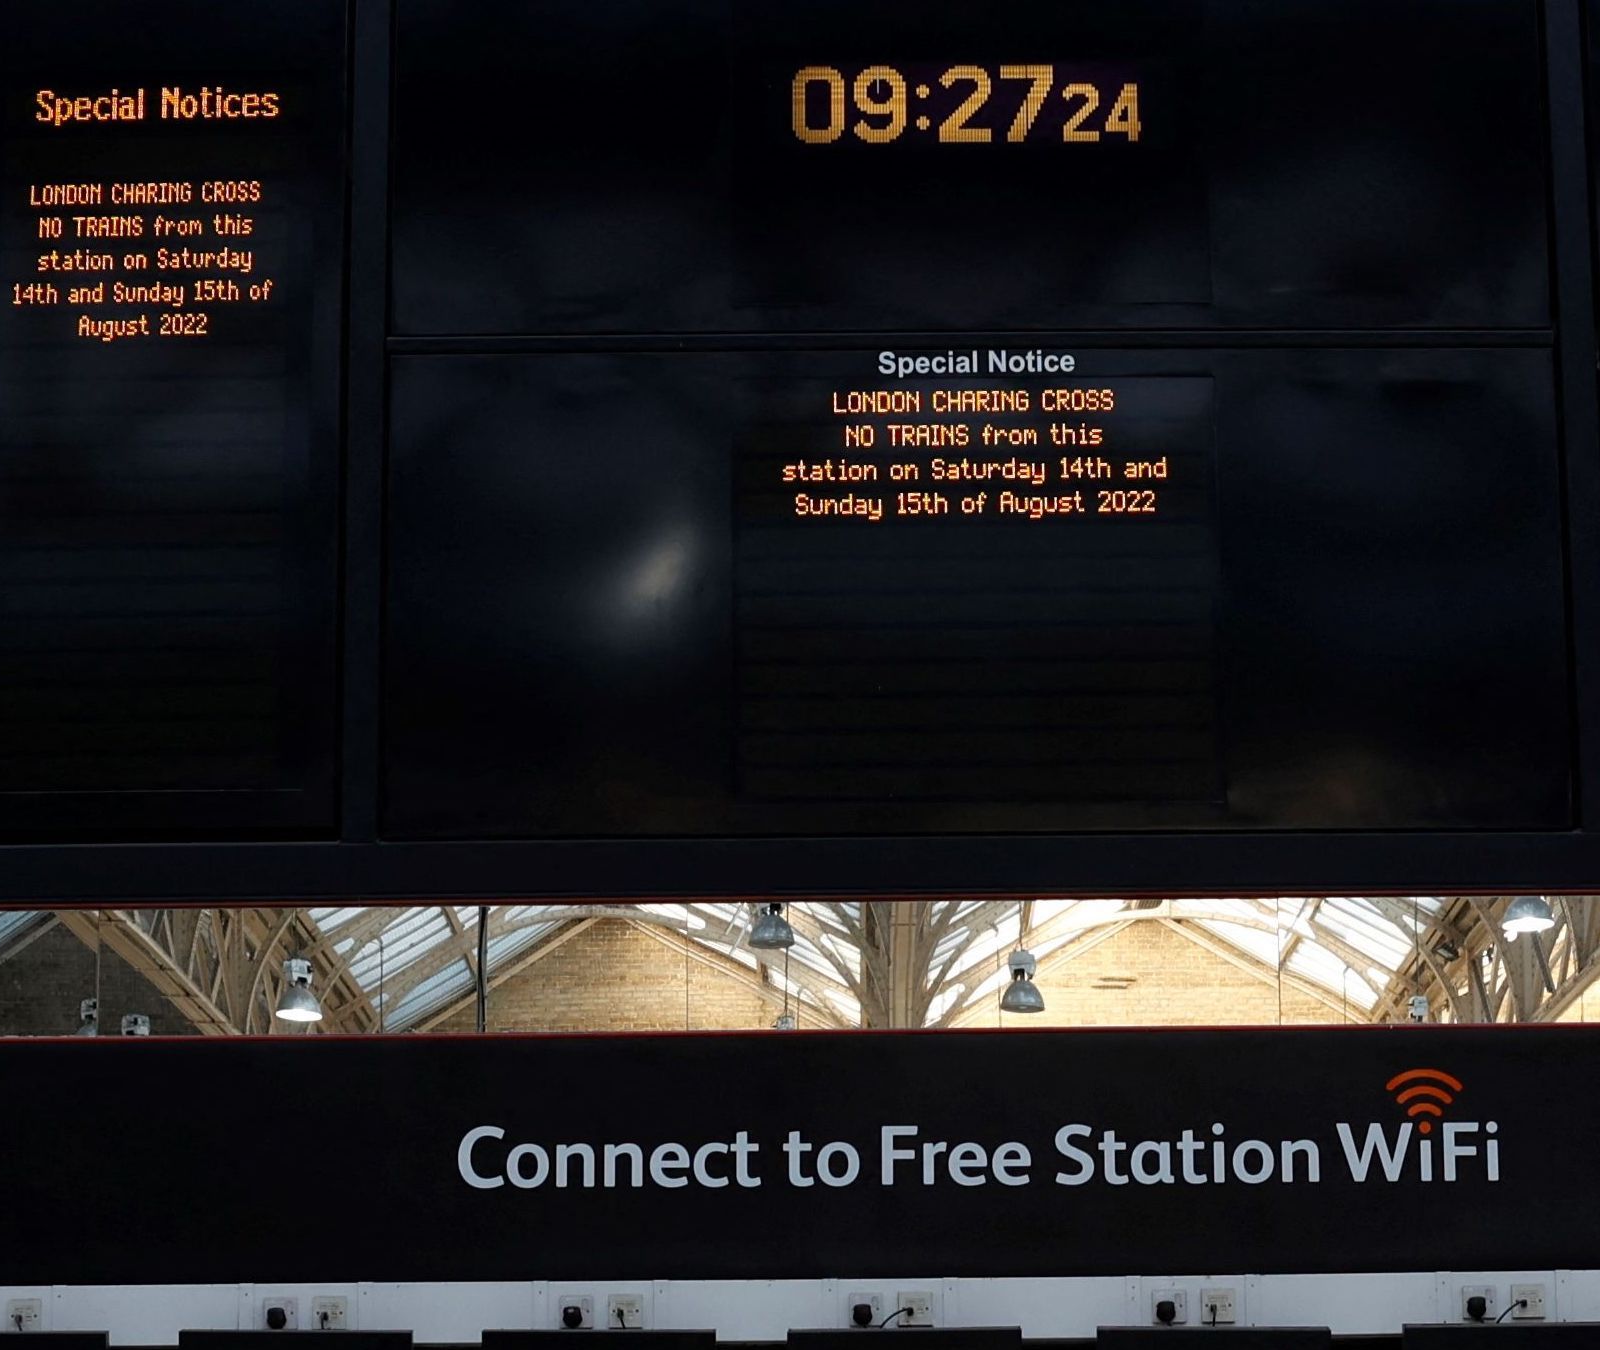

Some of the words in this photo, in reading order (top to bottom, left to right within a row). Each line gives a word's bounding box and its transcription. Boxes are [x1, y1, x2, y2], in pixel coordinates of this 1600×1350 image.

[792, 64, 1054, 144] 09:27
[1062, 83, 1142, 142] 24
[878, 350, 978, 378] Special
[988, 349, 1075, 373] Notice
[833, 390, 920, 414] LONDON
[932, 390, 1030, 413] CHARING
[1041, 388, 1114, 411] CROSS
[845, 424, 874, 448] NO
[887, 424, 970, 447] TRAINS
[981, 423, 1038, 446] from
[1049, 422, 1103, 445] this
[782, 458, 878, 482] station
[889, 463, 919, 481] on
[931, 457, 1046, 485] Saturday
[1060, 456, 1111, 479] 14th
[1123, 456, 1168, 479] and
[795, 493, 883, 521] Sunday
[897, 492, 948, 515] 15th
[961, 491, 988, 514] of
[999, 490, 1085, 519] August
[1097, 490, 1156, 513] 2022
[457, 1125, 762, 1189] Connect
[782, 1130, 860, 1187] to
[881, 1125, 1032, 1186] Free
[1054, 1122, 1320, 1186] Station
[1335, 1119, 1499, 1182] WiFi
